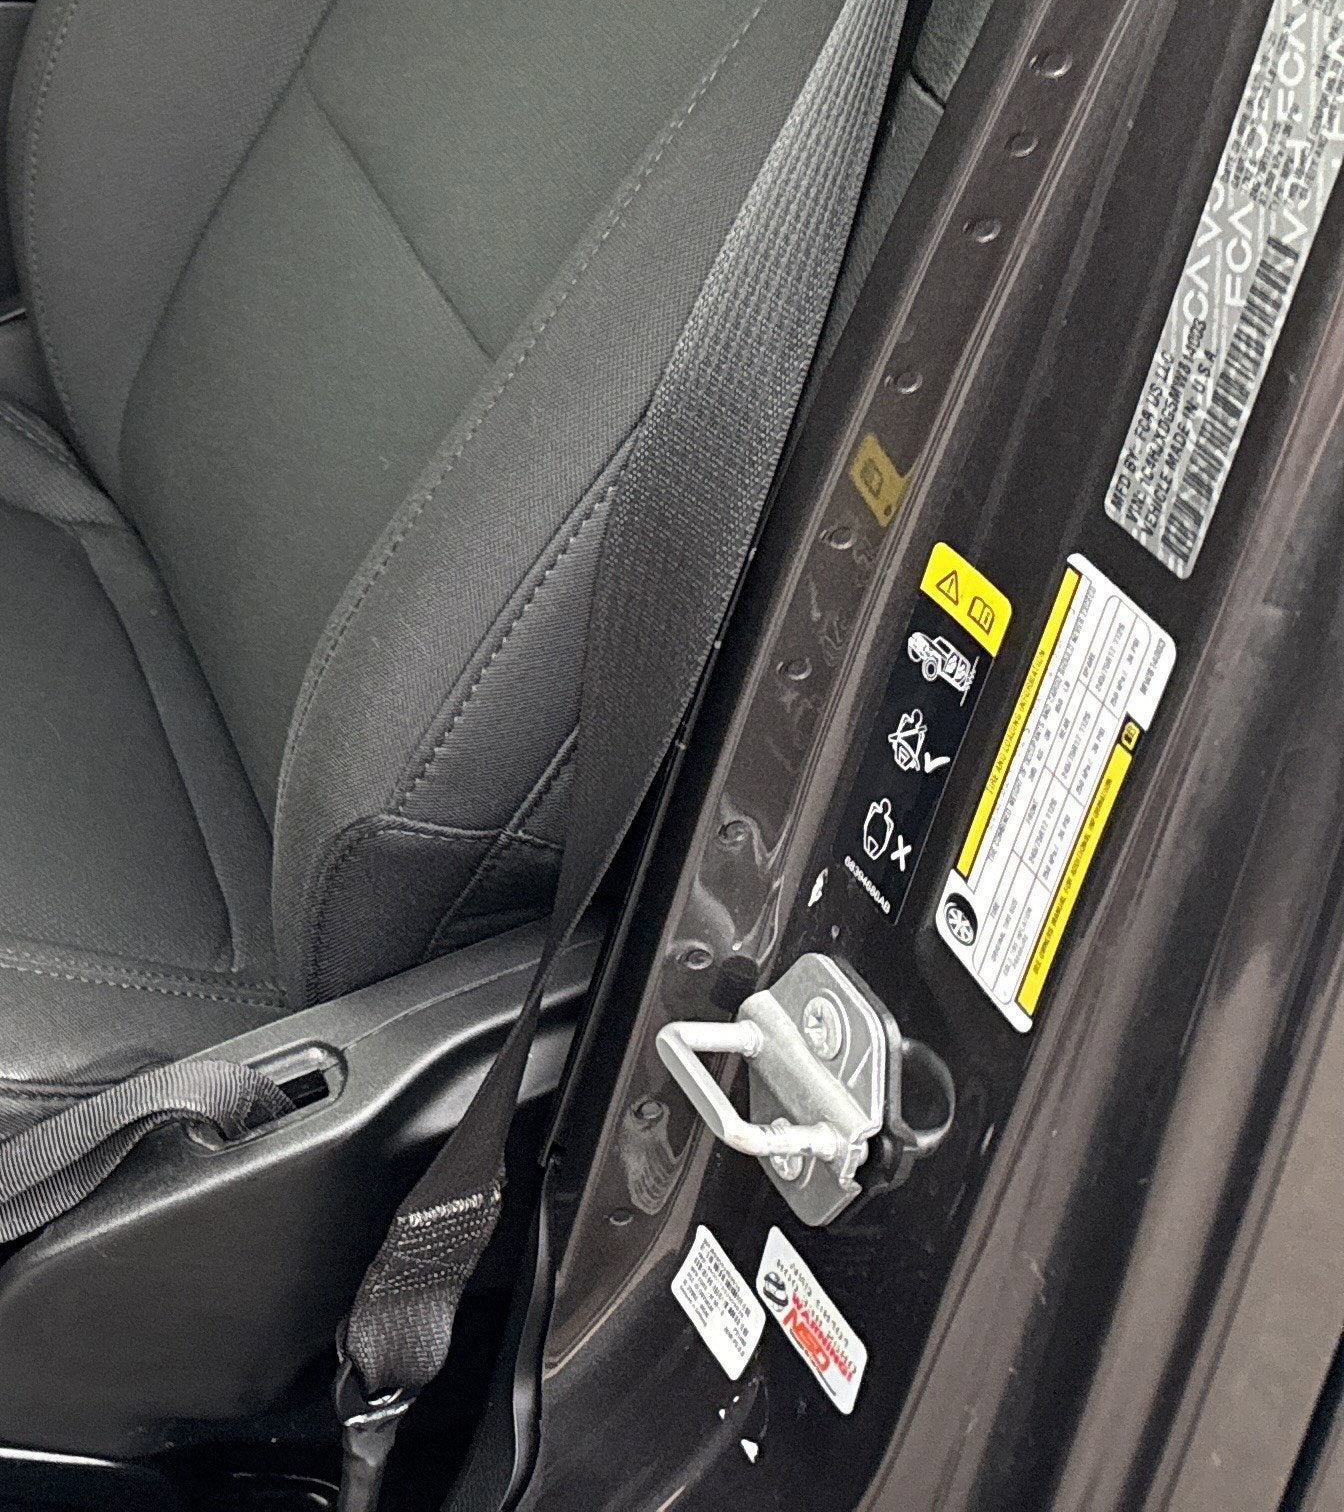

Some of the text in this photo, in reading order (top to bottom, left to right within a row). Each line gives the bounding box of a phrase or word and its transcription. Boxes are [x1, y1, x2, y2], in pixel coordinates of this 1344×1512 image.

[1110, 473, 1131, 512] MFD
[1134, 408, 1155, 441] FCA
[1145, 382, 1163, 408] US
[1155, 350, 1174, 382] LLC
[1140, 469, 1174, 536] VEHICLE
[1164, 421, 1191, 471] MADE
[1125, 490, 1147, 524] VIN:
